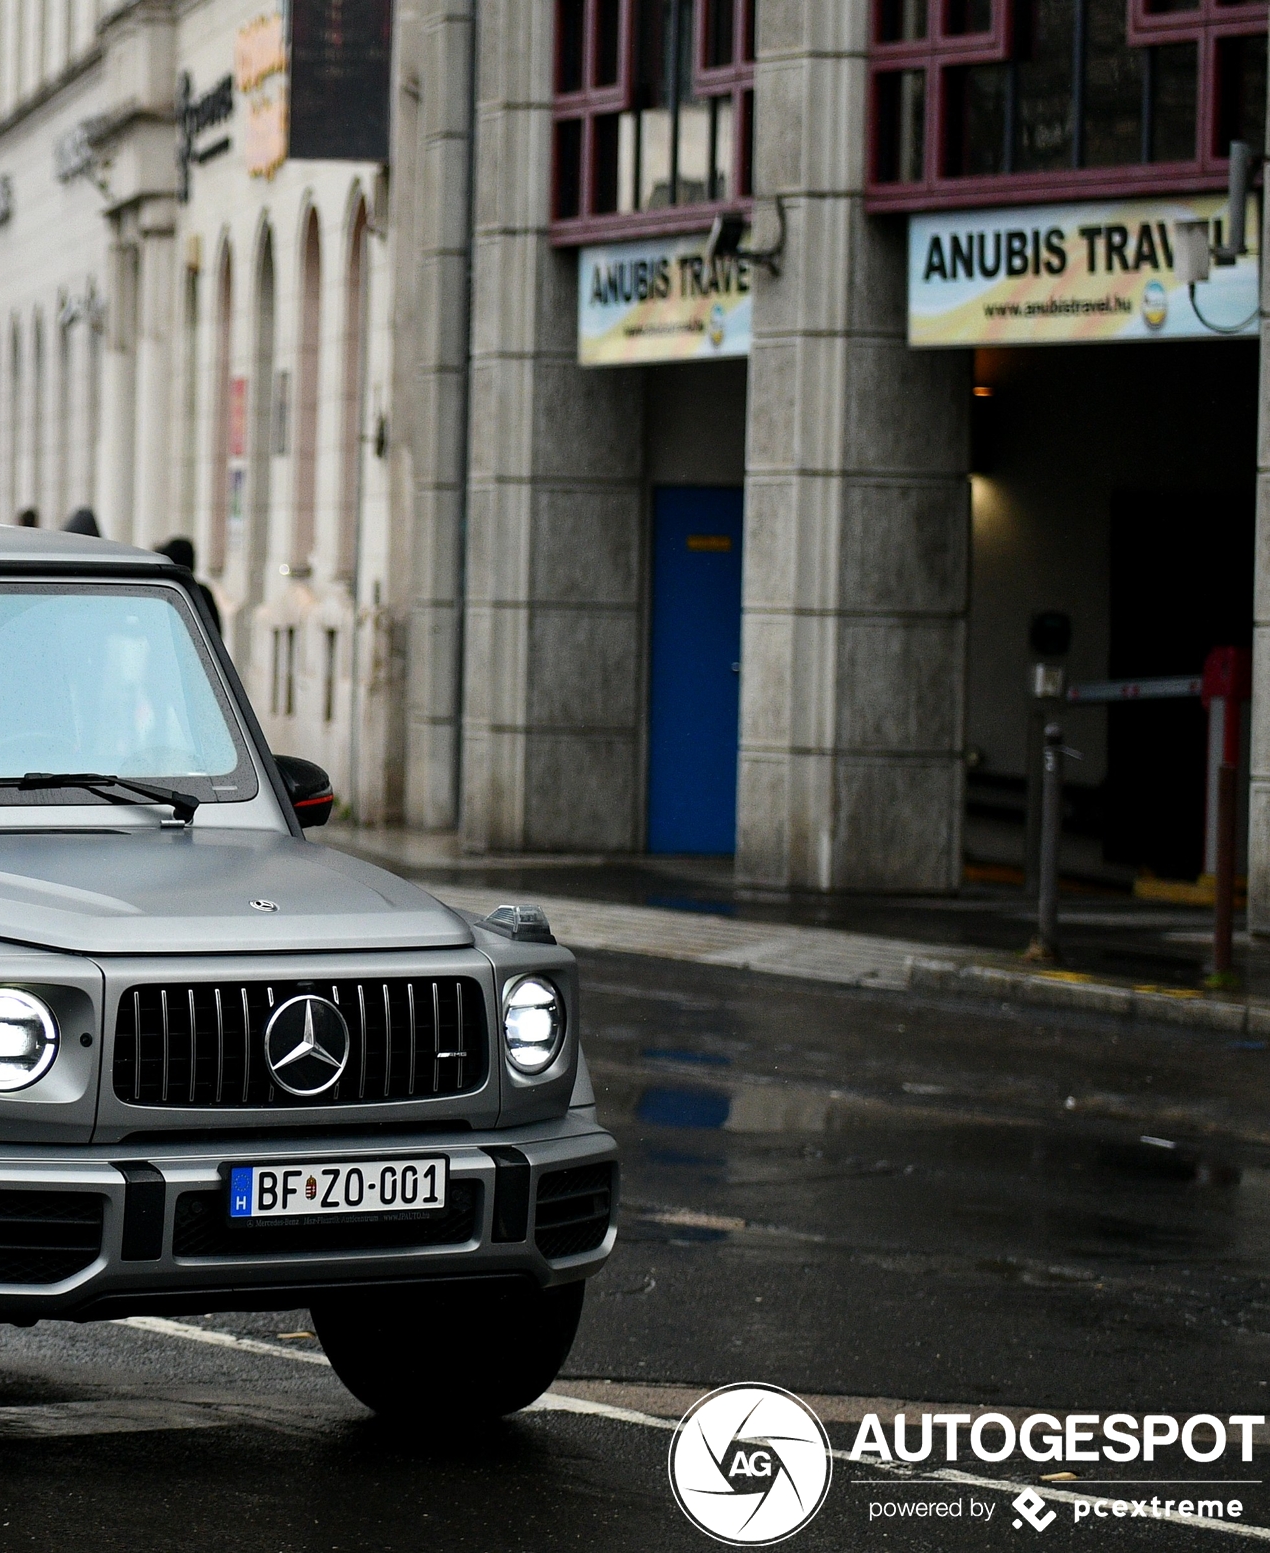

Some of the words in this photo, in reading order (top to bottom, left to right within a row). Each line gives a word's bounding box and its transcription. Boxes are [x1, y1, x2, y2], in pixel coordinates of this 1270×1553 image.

[924, 226, 1068, 281] ANUBIS
[1078, 218, 1236, 274] TRAVL
[591, 256, 671, 304] ANUBIS
[983, 293, 1132, 319] www.anubistravel.hu
[235, 1195, 247, 1211] H
[258, 1170, 303, 1211] BF
[320, 1164, 439, 1208] ZO-001
[255, 1217, 300, 1227] Mercedes-Benz
